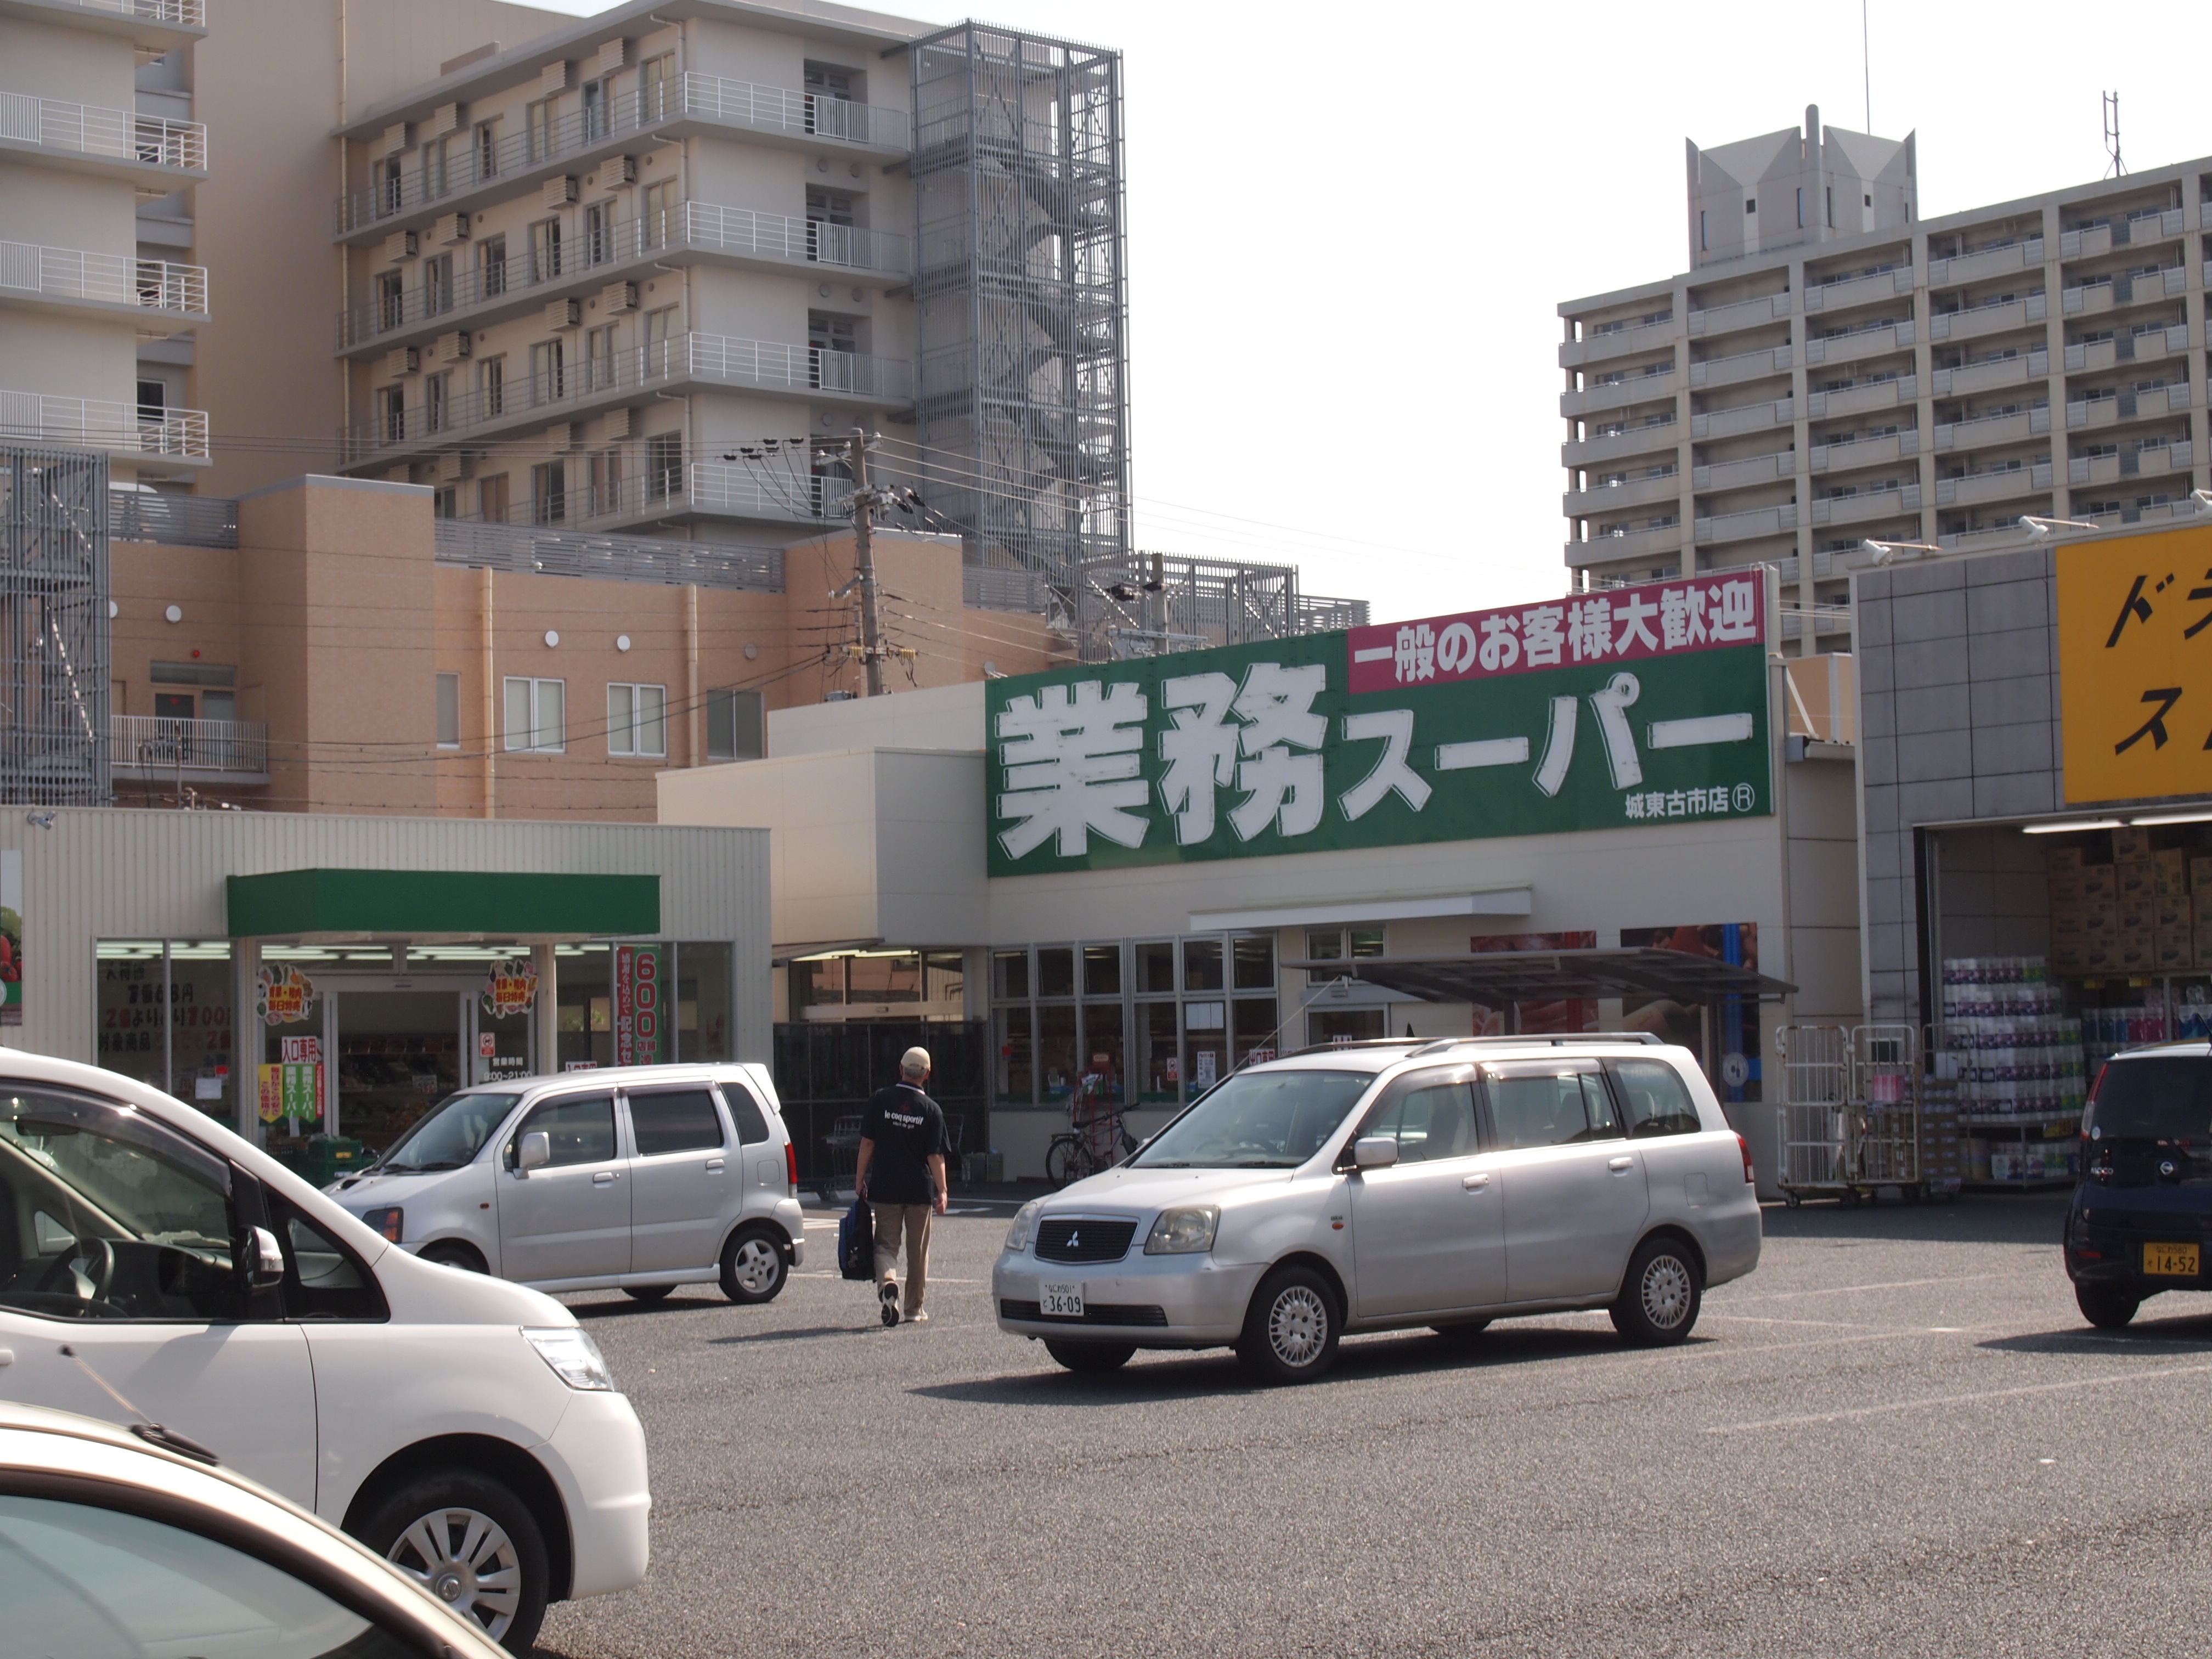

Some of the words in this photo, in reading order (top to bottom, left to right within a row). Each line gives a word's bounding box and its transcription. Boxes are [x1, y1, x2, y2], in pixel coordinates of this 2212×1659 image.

[1355, 580, 1756, 683] 一般のお客様大歓迎
[995, 663, 1753, 860] 業務スーパー
[1625, 786, 1729, 819] 城東古市店
[283, 1038, 317, 1063] 入口専用
[302, 1066, 313, 1119] 業務スーパー
[884, 1109, 891, 1119] le
[891, 1112, 902, 1122] coq
[902, 1114, 924, 1125] sportif
[2157, 1256, 2195, 1273] 14-52
[1049, 1295, 1081, 1313] 36-09
